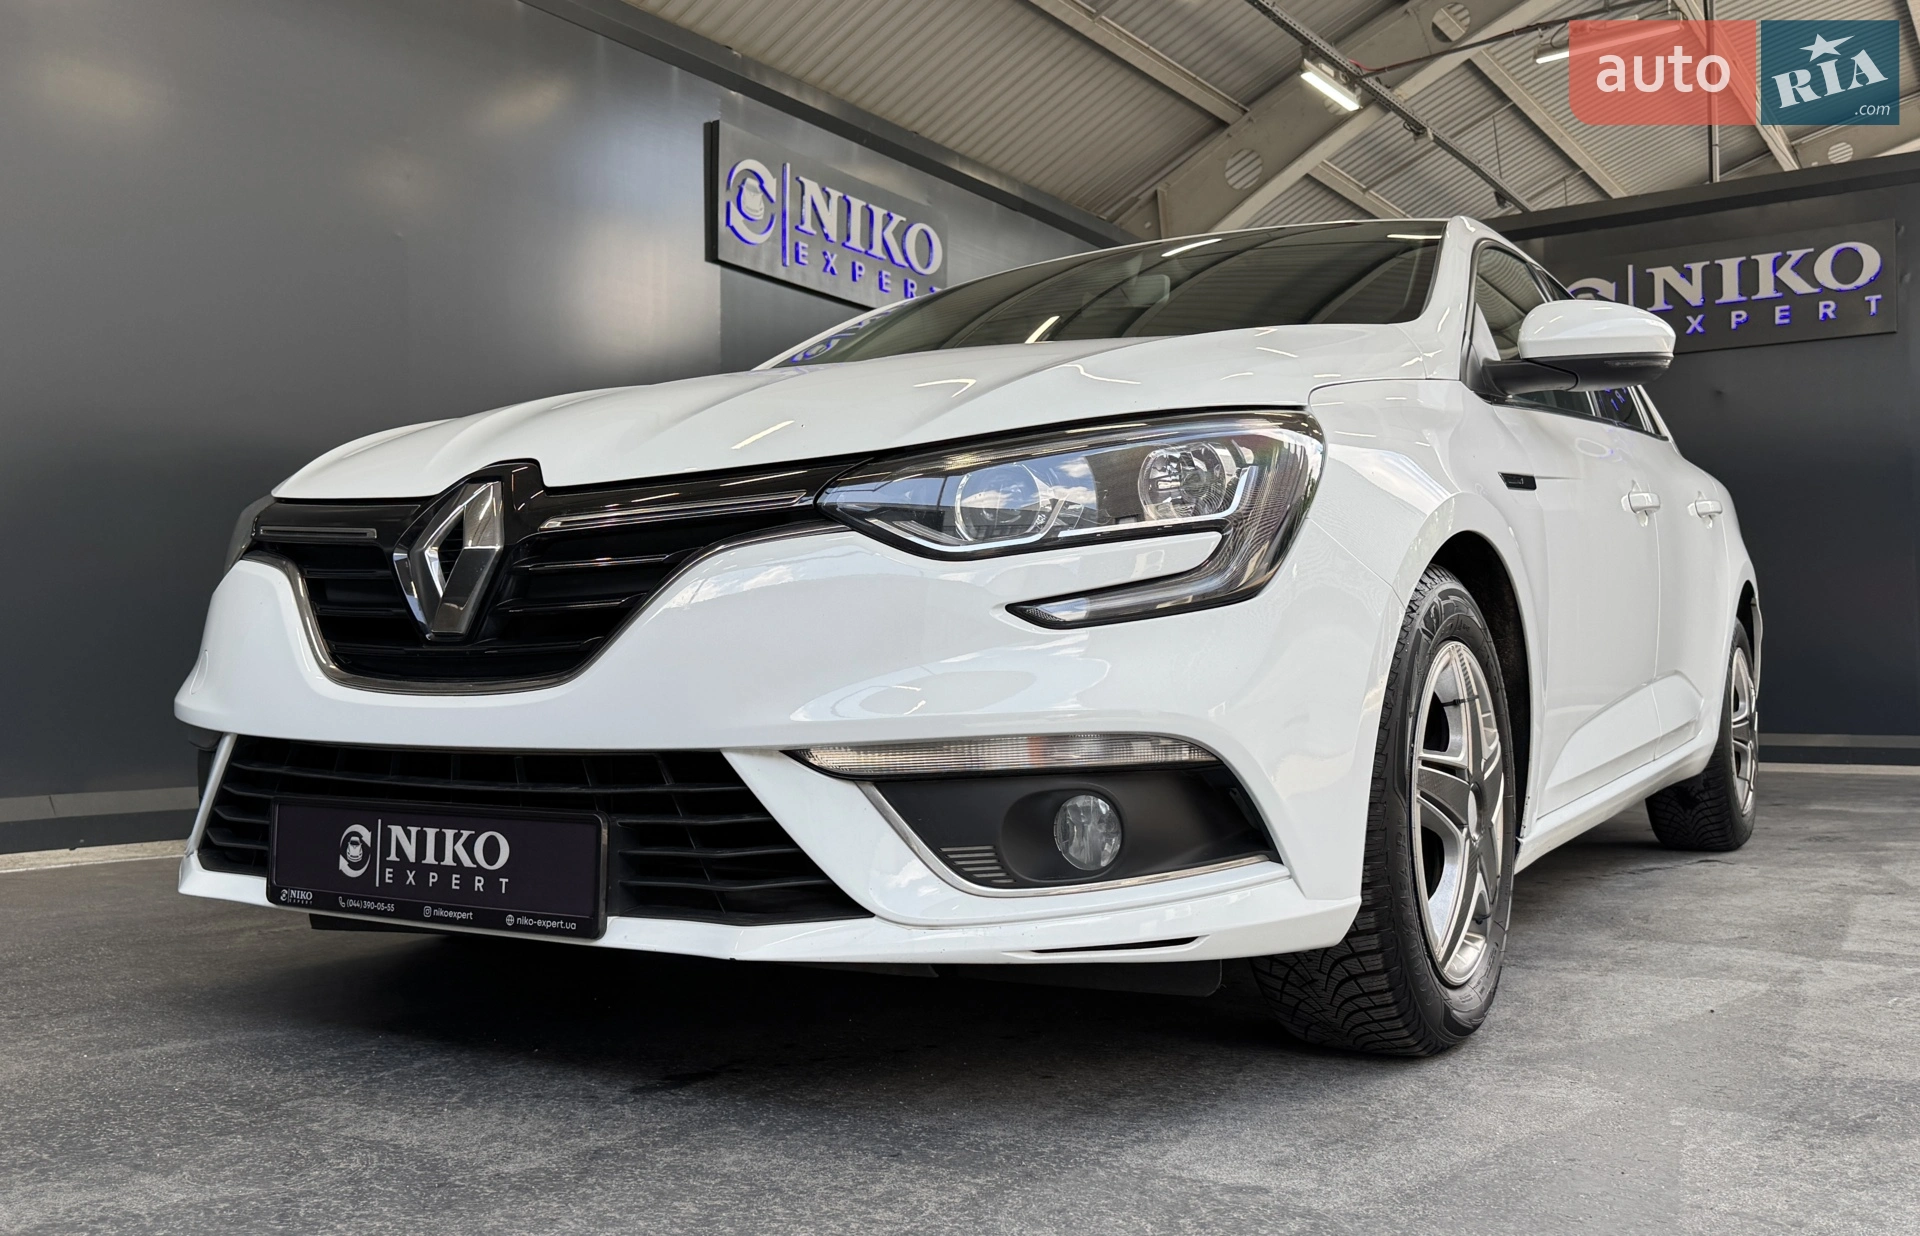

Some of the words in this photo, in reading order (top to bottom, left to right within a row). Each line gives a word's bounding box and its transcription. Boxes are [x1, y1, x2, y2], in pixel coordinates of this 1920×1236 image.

[795, 176, 943, 275] NIKO
[795, 241, 942, 298] EXPER
[1646, 241, 1883, 312] NIKO
[1686, 294, 1883, 335] XPERT
[386, 825, 510, 870] NIKO
[289, 889, 312, 901] NIKO
[385, 868, 509, 893] EXPERT
[433, 908, 473, 920] nikoexpert
[516, 916, 577, 930] niko-expert.ua
